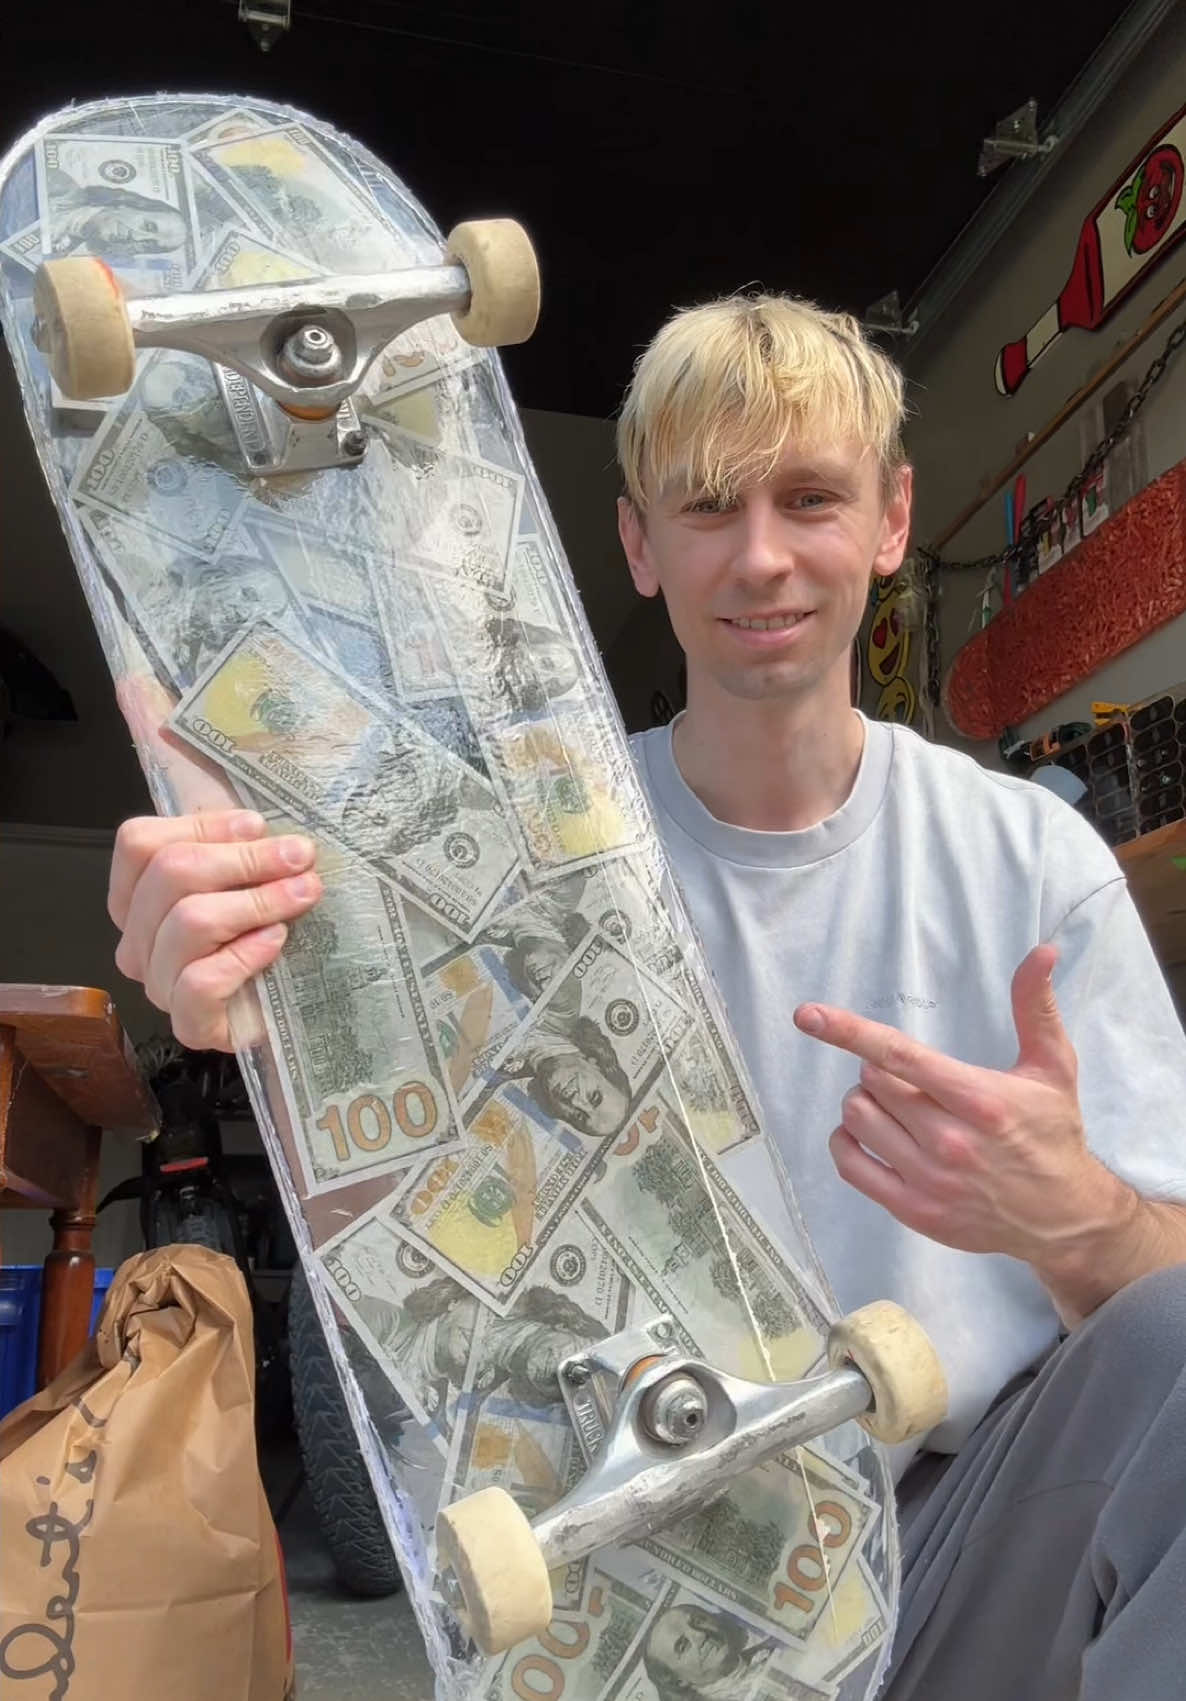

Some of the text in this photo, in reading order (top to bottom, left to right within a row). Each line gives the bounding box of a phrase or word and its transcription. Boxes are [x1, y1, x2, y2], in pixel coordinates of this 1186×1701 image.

[47, 143, 60, 169] 100
[165, 145, 183, 175] 100
[87, 449, 116, 491] 100
[193, 718, 238, 753] 100
[429, 892, 471, 925] 100
[316, 1080, 439, 1162] 100
[411, 1159, 459, 1216] 100
[327, 1257, 361, 1302] 100
[500, 1245, 534, 1287] 100
[774, 1501, 852, 1614] 100
